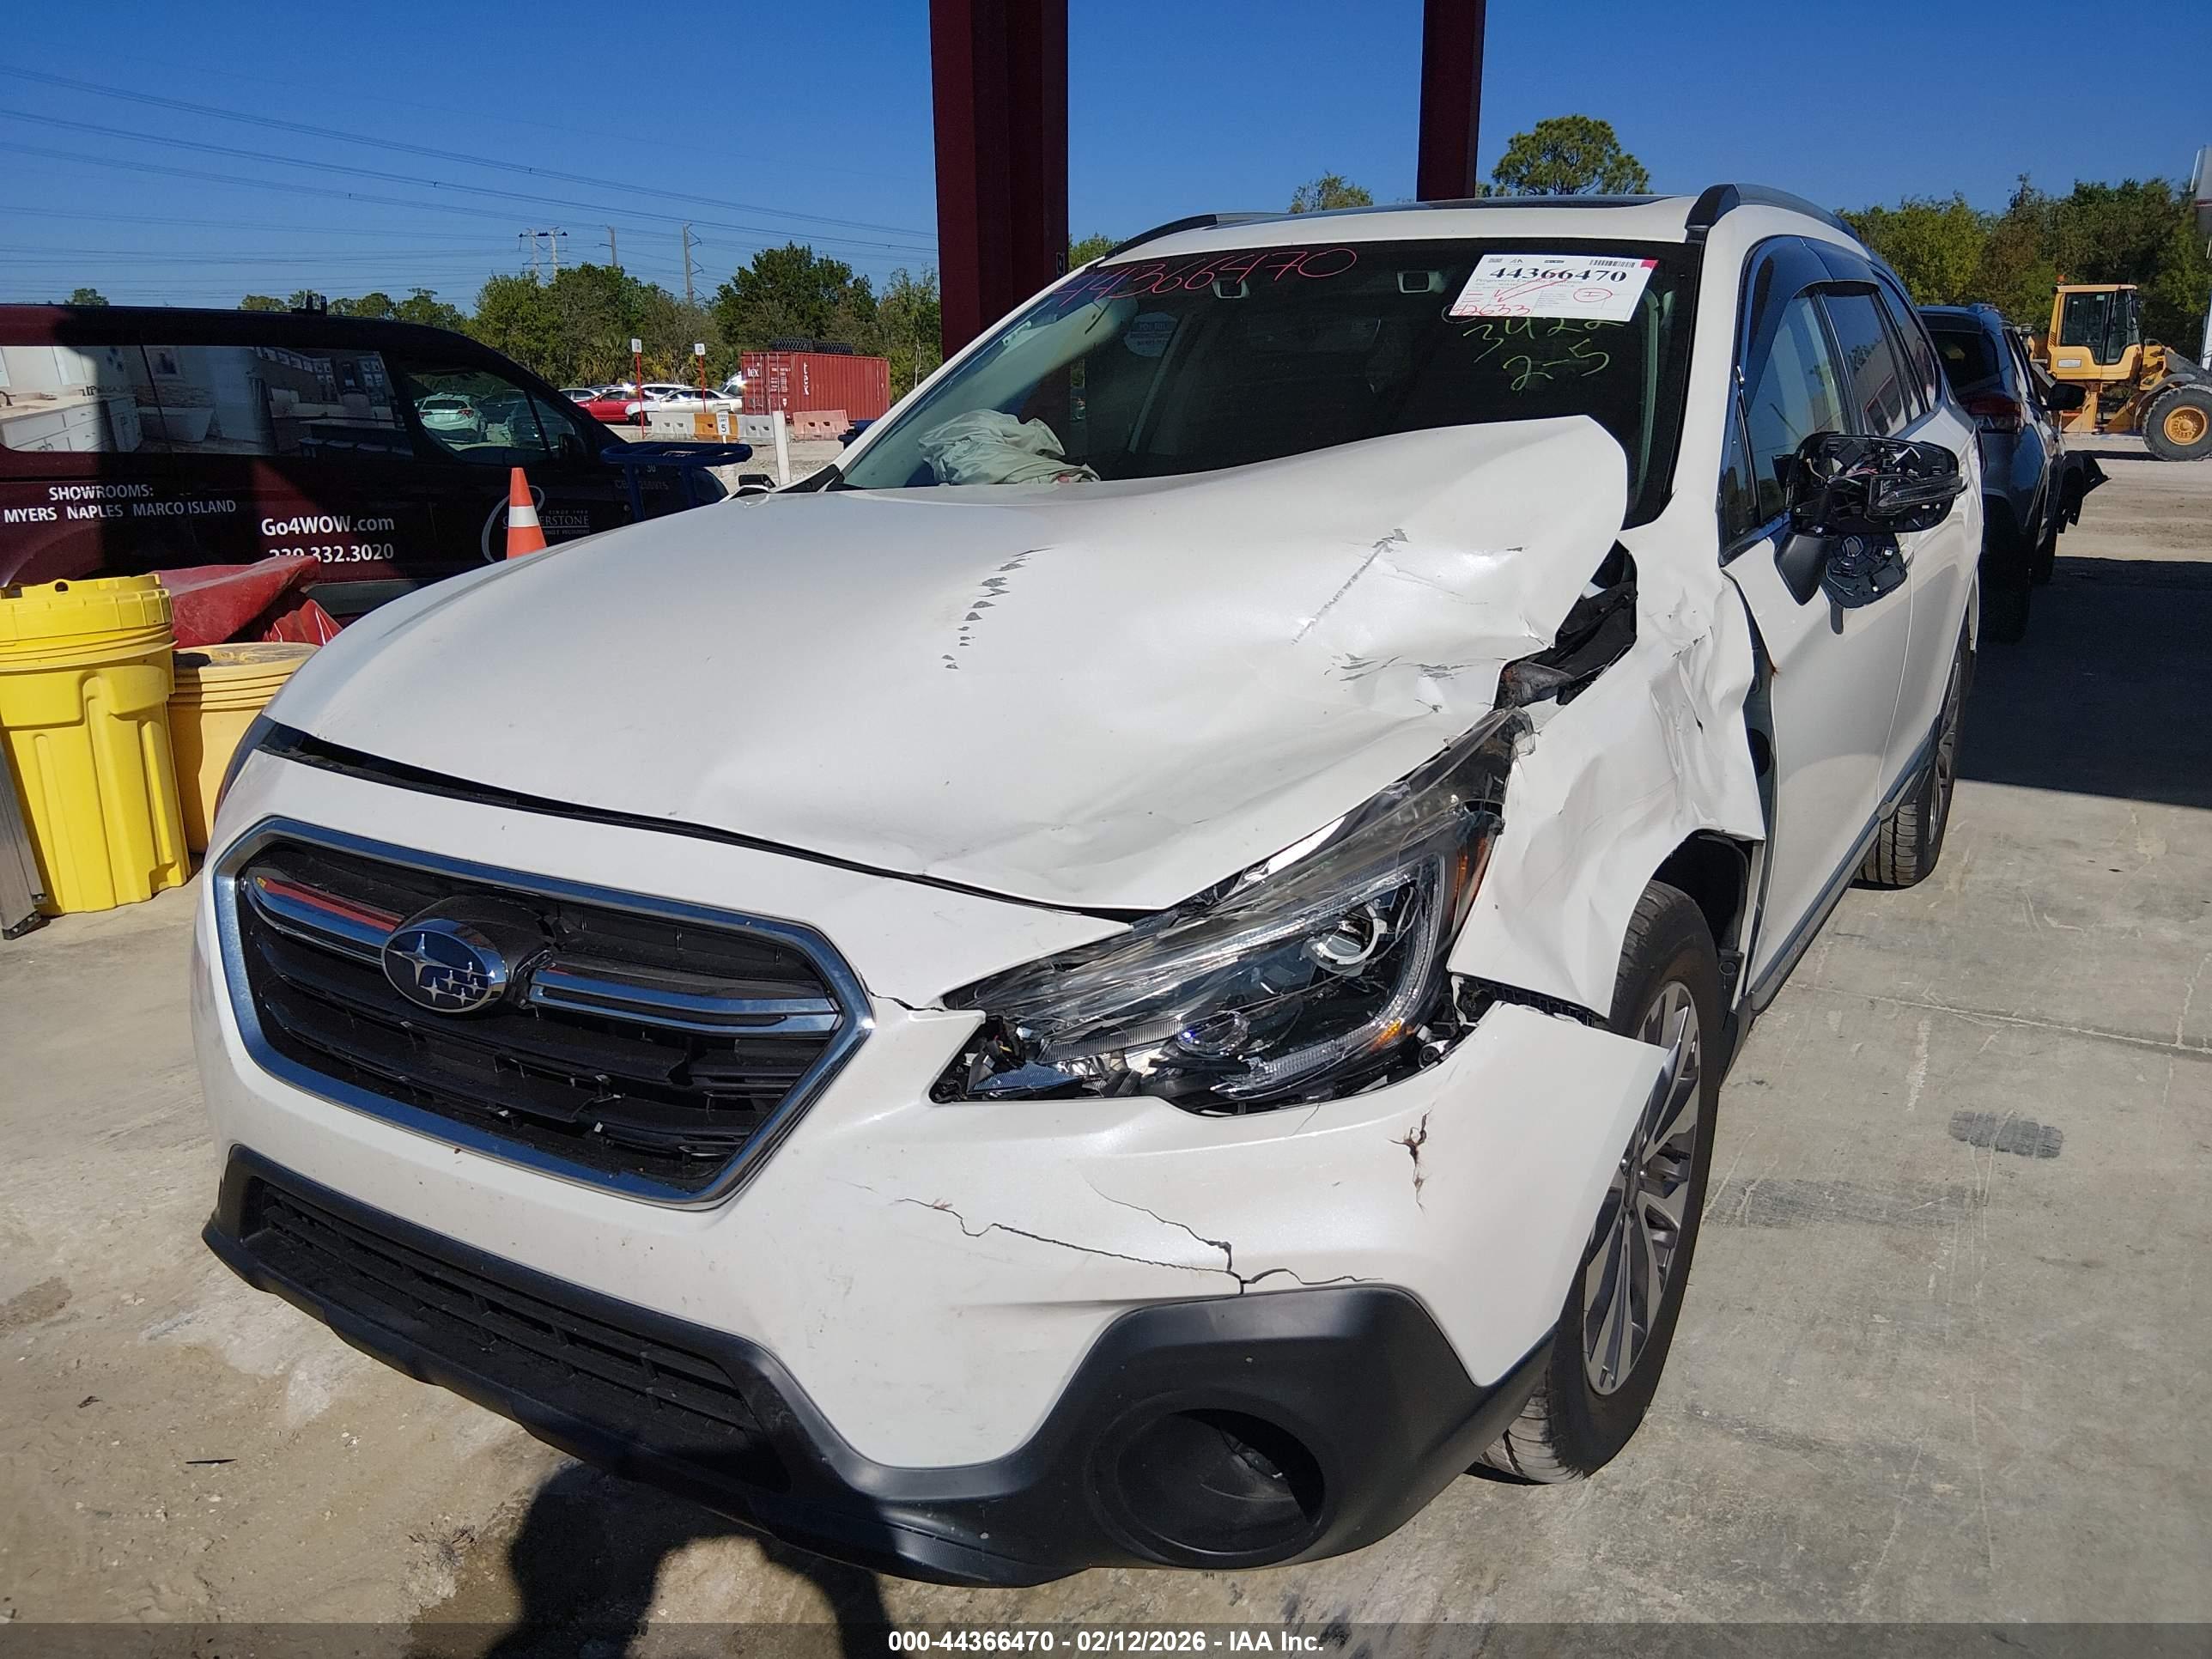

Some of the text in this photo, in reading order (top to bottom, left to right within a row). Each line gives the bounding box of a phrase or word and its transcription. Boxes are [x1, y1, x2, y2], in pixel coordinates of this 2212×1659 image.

[1052, 247, 1358, 307] 44366470
[1489, 266, 1627, 283] 44366470
[720, 423, 727, 433] 5
[48, 484, 155, 501] SHOWROOMS:
[4, 499, 237, 523] MYERS NAPLES MARCO ISLAND
[502, 514, 590, 526] CERSTONE
[261, 514, 395, 537] Go4WOW.com
[269, 543, 394, 563] 332.3020
